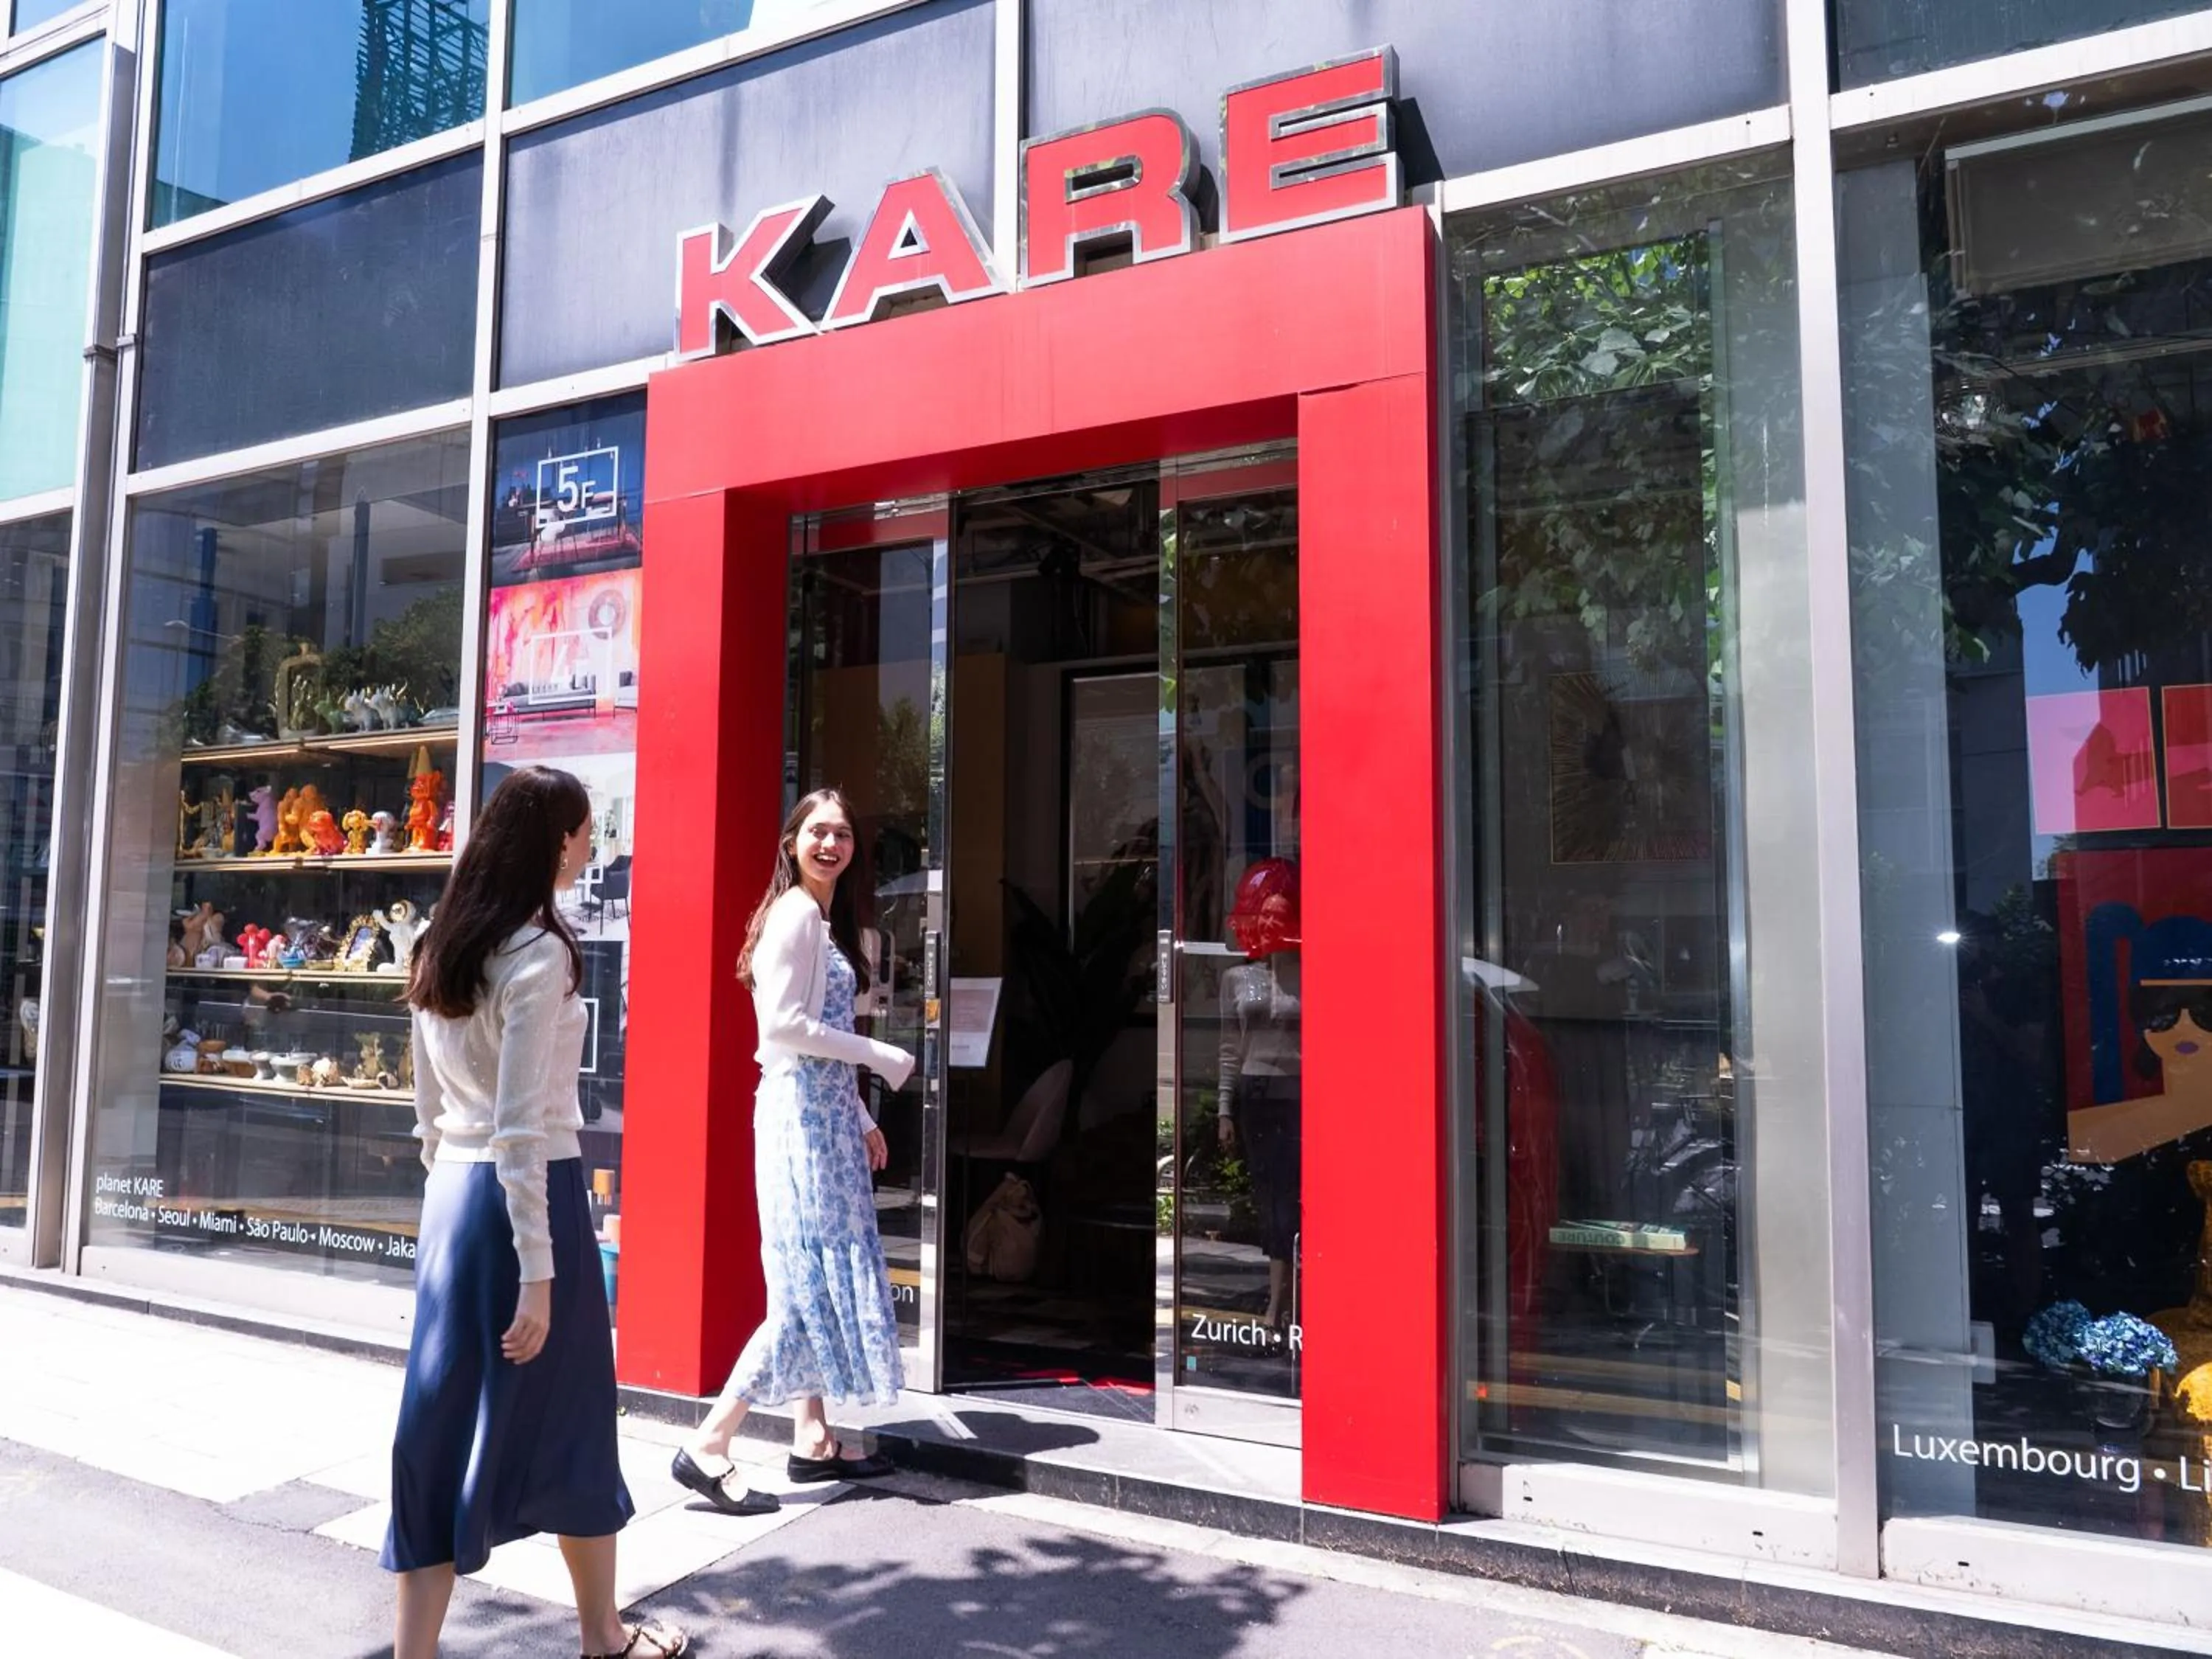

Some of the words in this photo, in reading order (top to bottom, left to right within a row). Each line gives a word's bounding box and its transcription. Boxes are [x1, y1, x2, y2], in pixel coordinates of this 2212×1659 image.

[675, 44, 1401, 361] KARE
[557, 465, 597, 512] 5F
[96, 1172, 132, 1193] planet
[134, 1177, 164, 1197] KARE
[94, 1197, 149, 1221] Barcelona
[157, 1206, 190, 1227] Seoul
[199, 1211, 237, 1233] Miami
[272, 1220, 307, 1243] Paulo
[319, 1226, 375, 1253] Moscow
[1191, 1313, 1267, 1346] Zurich
[1893, 1424, 2140, 1492] Luxembourg
